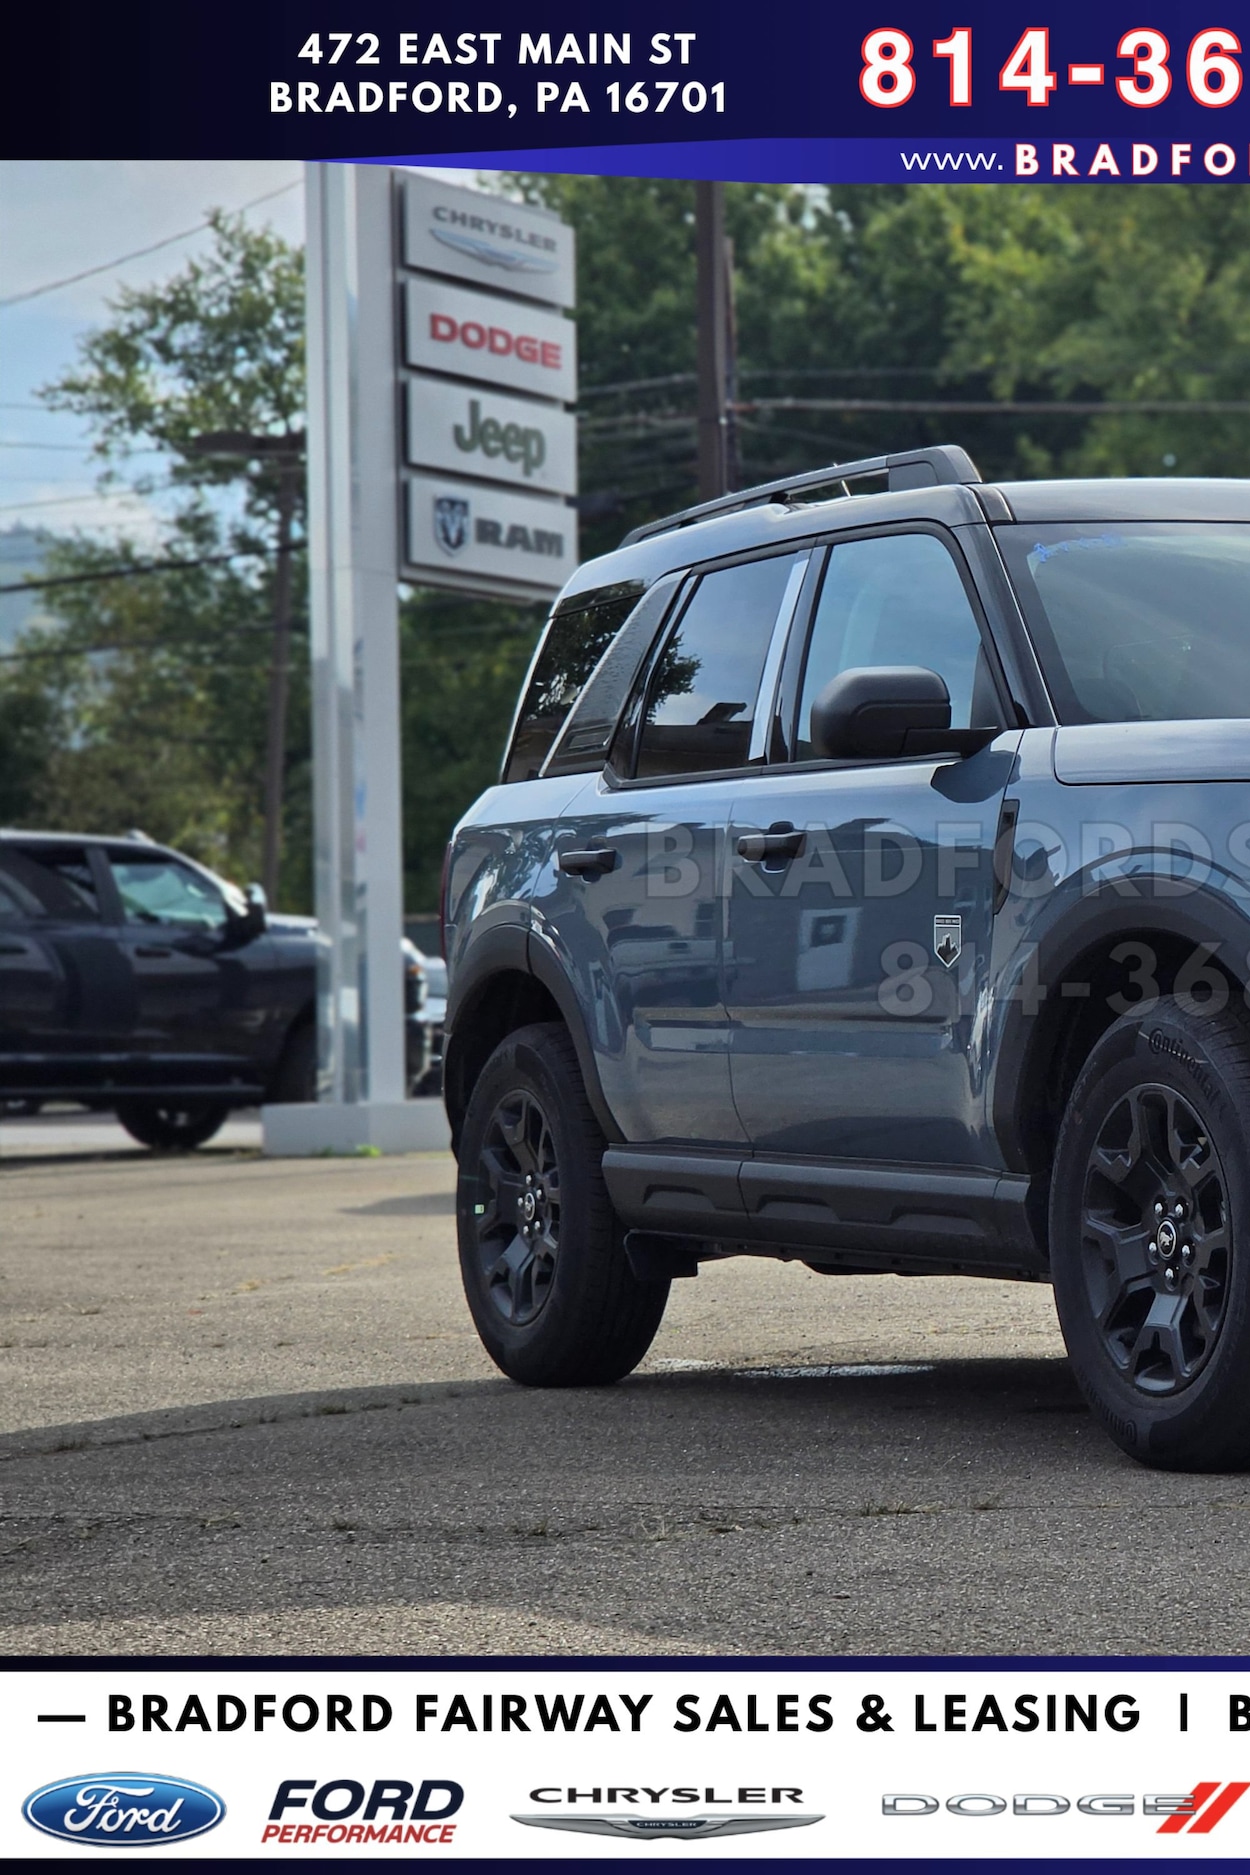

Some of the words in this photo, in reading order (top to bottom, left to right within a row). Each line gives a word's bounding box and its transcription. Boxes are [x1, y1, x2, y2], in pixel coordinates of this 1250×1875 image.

[432, 206, 557, 252] CHRYSLER
[430, 312, 562, 370] DODGE
[453, 399, 546, 477] Jeep
[474, 517, 564, 558] RAM
